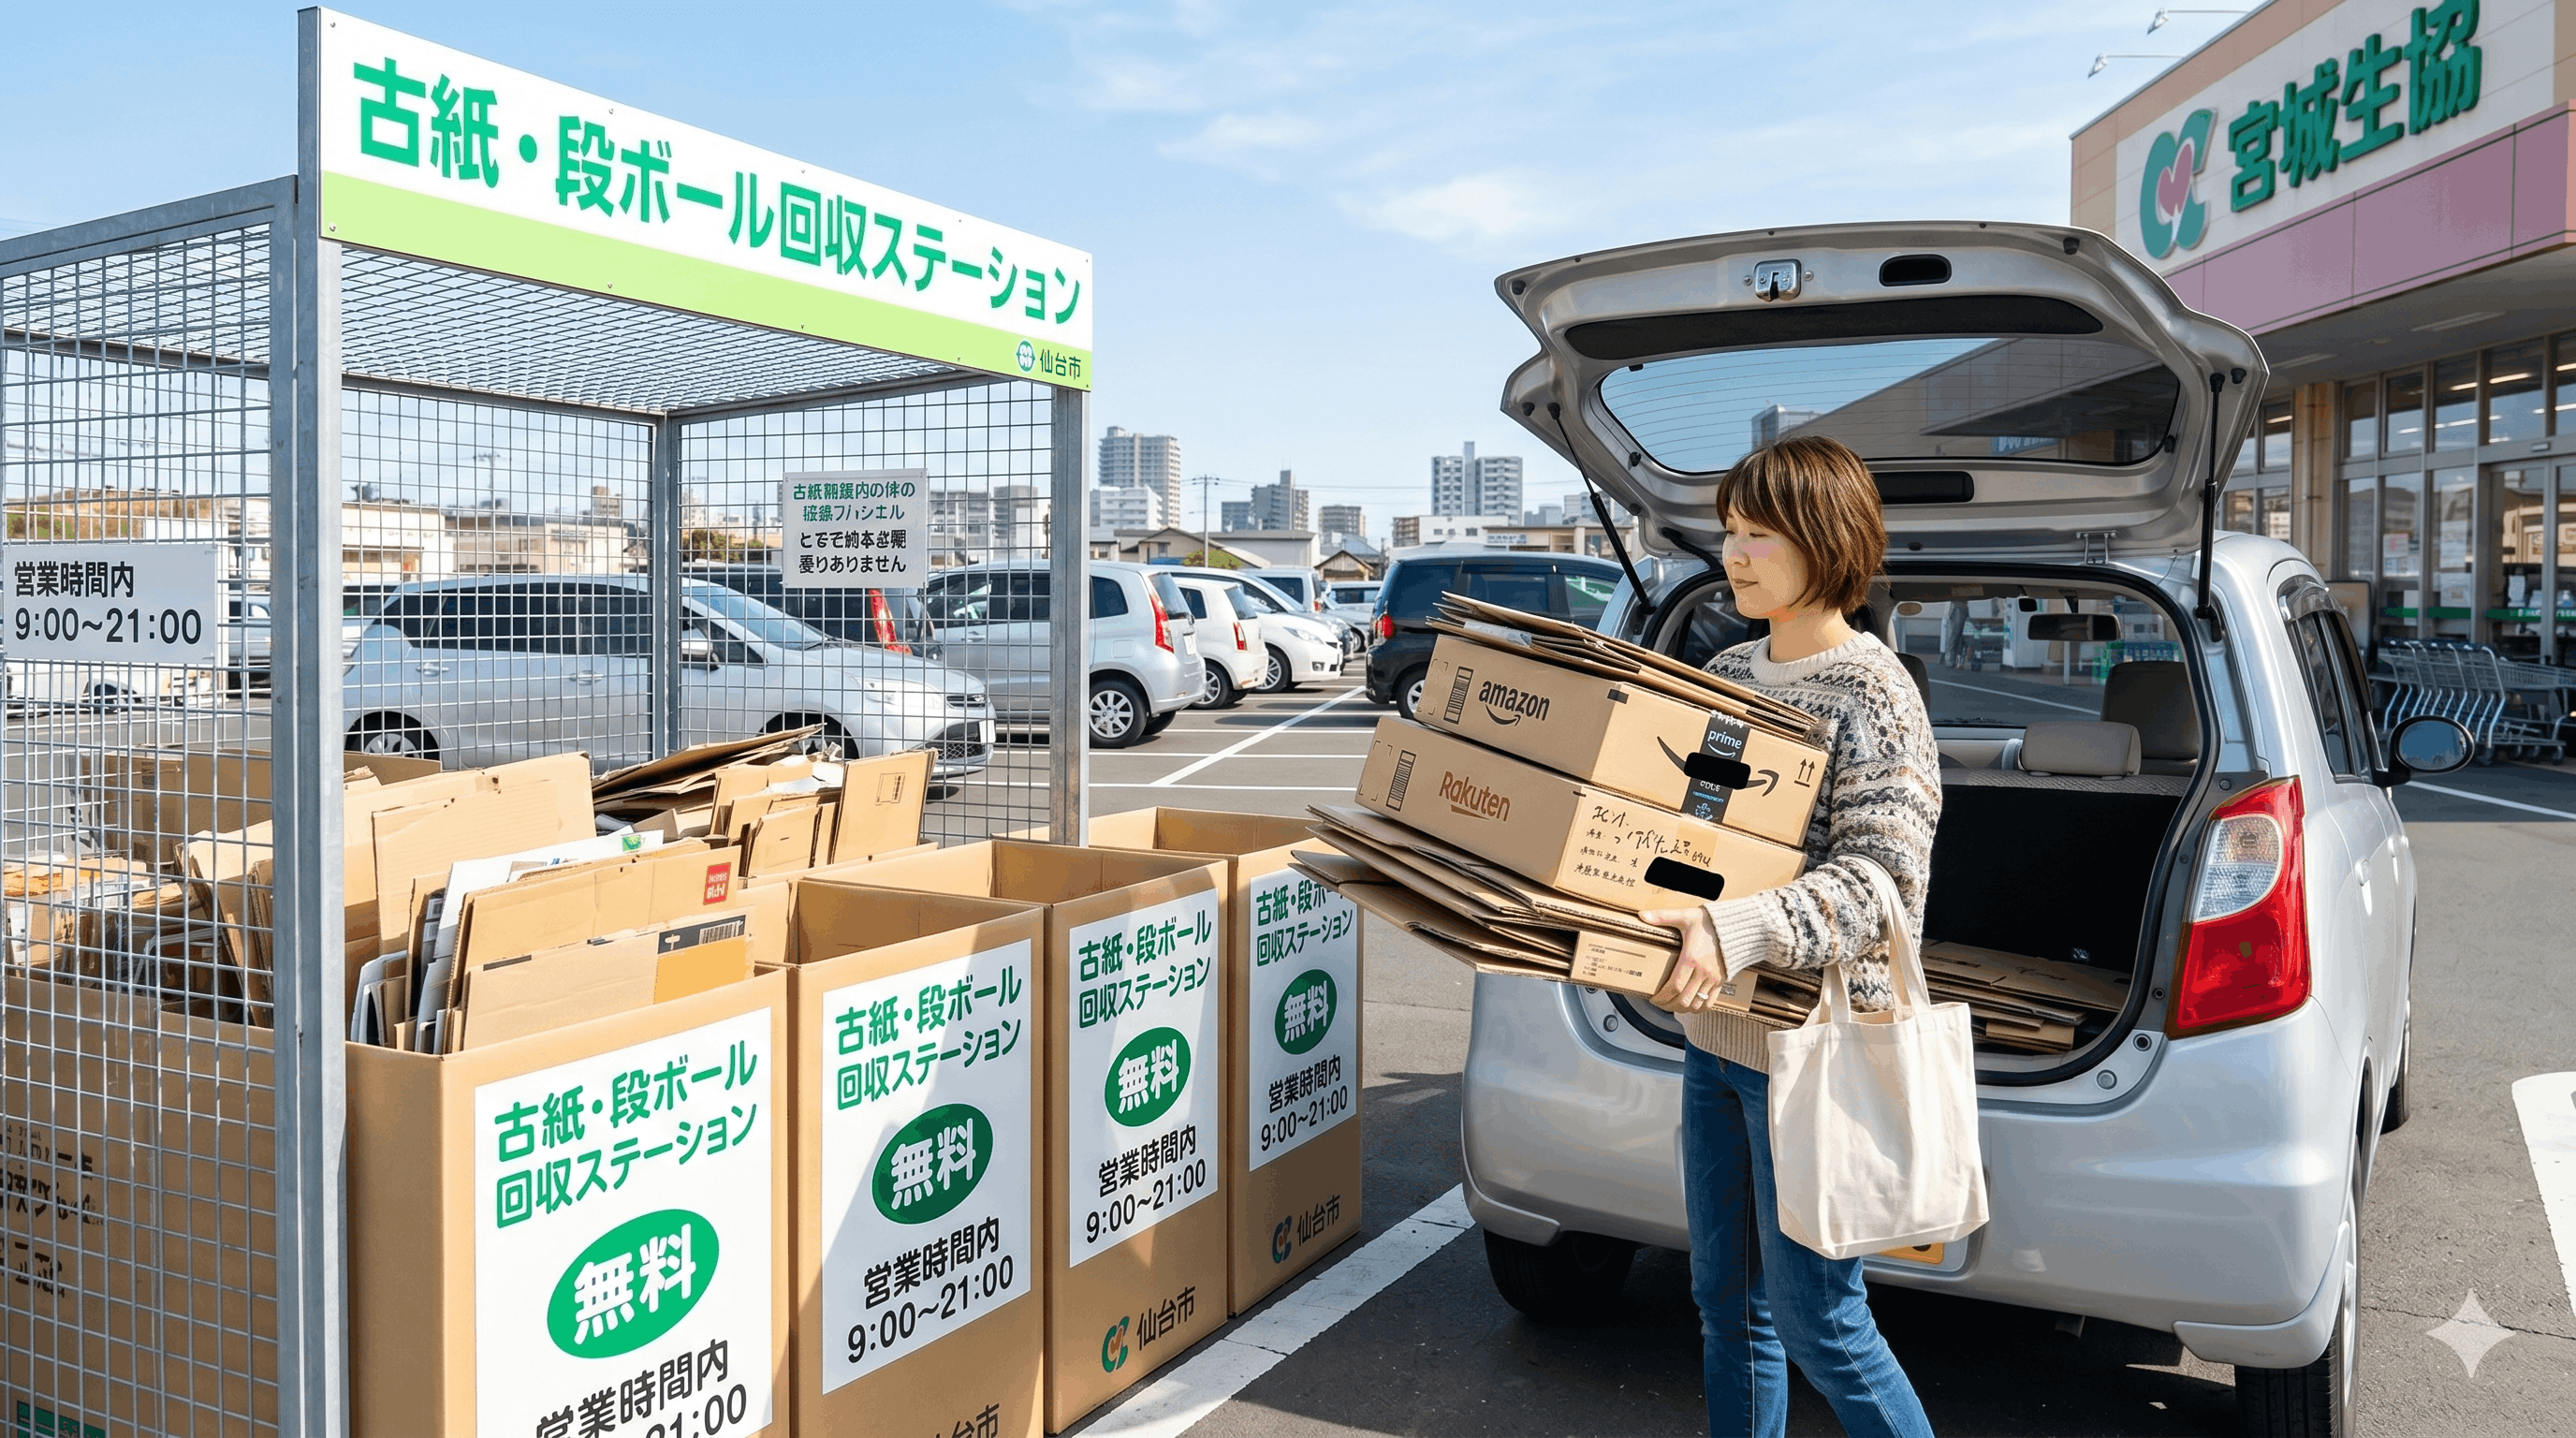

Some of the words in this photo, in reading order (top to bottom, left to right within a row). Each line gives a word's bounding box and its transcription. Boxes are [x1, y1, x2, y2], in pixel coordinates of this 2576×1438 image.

[2228, 0, 2482, 213] 宮城生協
[353, 57, 1081, 325] 古紙・段ボール回収ステーション
[1039, 348, 1081, 380] 仙台市
[14, 561, 134, 597] 営業時間内
[1478, 681, 1550, 722] amazon
[1707, 730, 1742, 749] prime
[1439, 770, 1511, 822] Rakuten
[1256, 879, 1343, 927] 古紙・段ボ
[1256, 909, 1353, 967] 回収ステーション
[1078, 909, 1212, 982] 古紙・段ボール
[835, 964, 1022, 1056] 古紙・段ボール
[1079, 956, 1211, 1029] 回収ステーション
[1284, 980, 1329, 1043] 無料
[494, 1040, 757, 1163] 古紙・段ボール
[837, 1019, 1021, 1111] 回収ステーション
[1118, 1038, 1179, 1114] 無料
[1268, 1054, 1340, 1113] 営業時間内
[496, 1103, 757, 1228] 回収ステーション
[891, 1118, 976, 1210] 無料
[1098, 1123, 1196, 1198] 営業時間内
[1296, 1194, 1341, 1247] 仙台市
[574, 1223, 696, 1344] 無料
[864, 1216, 999, 1310] 営業時間内
[1136, 1285, 1195, 1351] 仙台市
[536, 1339, 728, 1438] 営業時間内
